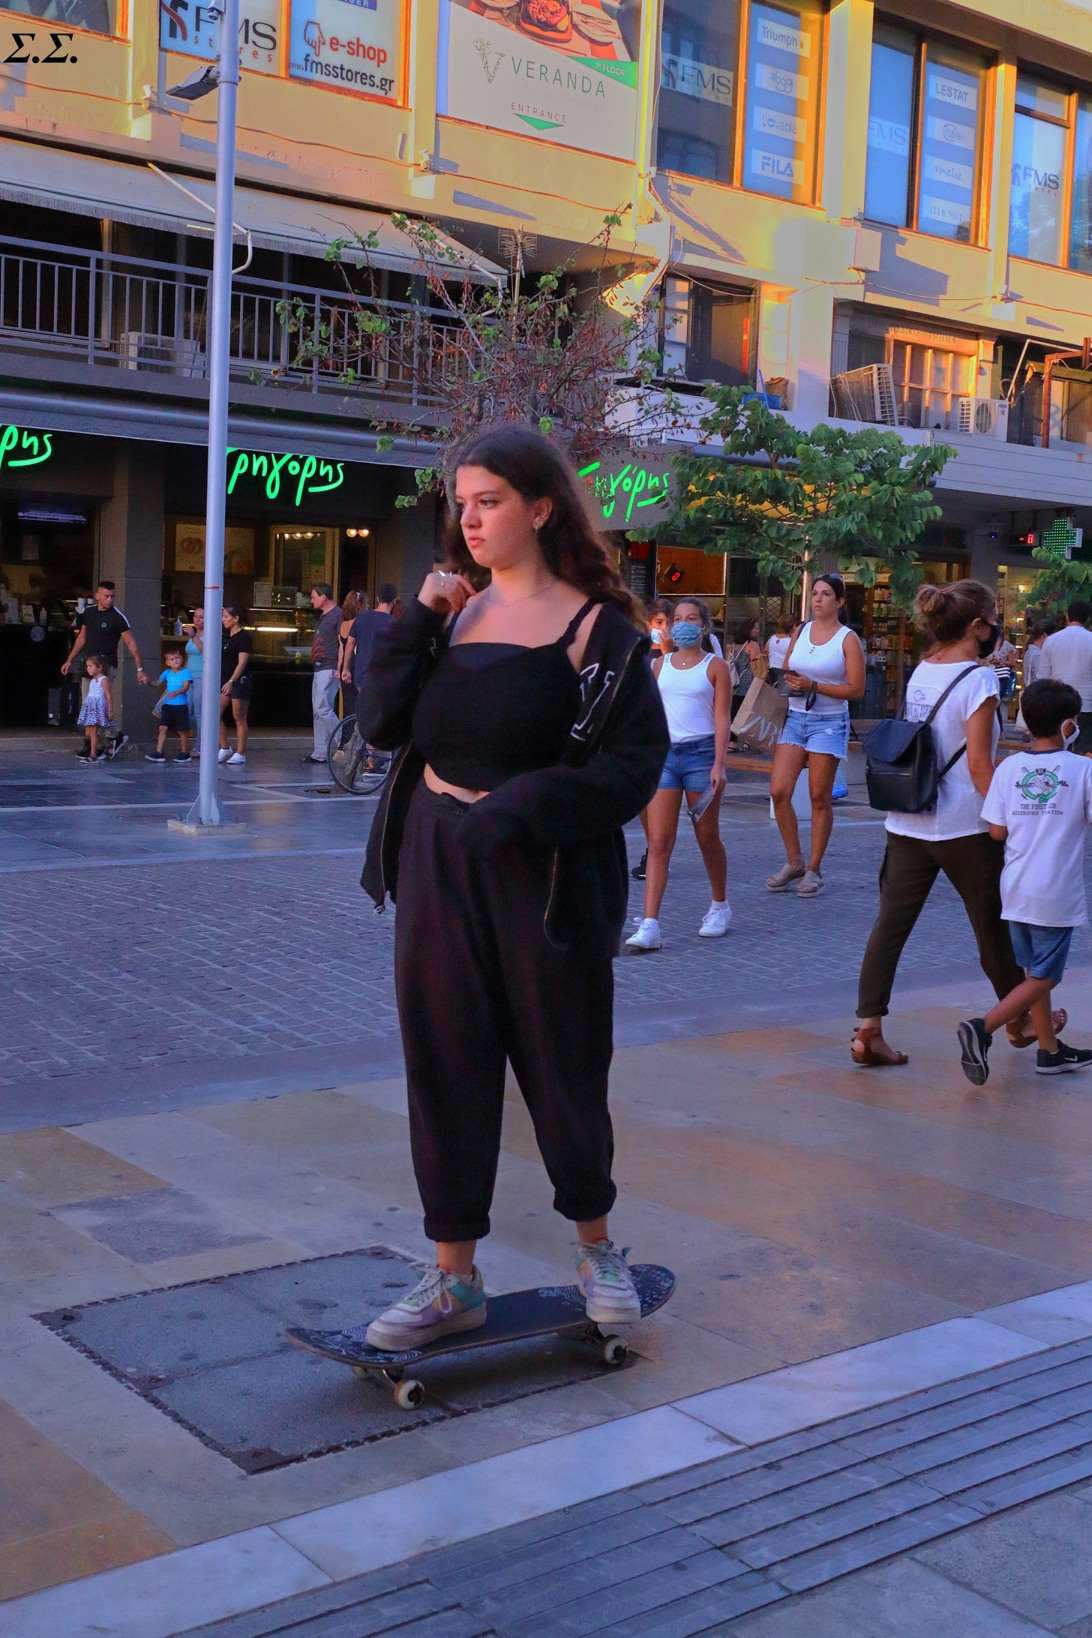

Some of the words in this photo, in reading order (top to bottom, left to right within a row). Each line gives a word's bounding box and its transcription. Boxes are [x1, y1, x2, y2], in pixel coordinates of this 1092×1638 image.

[194, 35, 273, 62] stres
[762, 26, 798, 47] Triumph
[329, 36, 387, 68] e-shop
[511, 56, 606, 98] VERANDA
[602, 64, 626, 76] FLOOR
[681, 65, 731, 95] FMS
[936, 81, 969, 102] LESTAT
[511, 102, 567, 123] ENTRANCE
[762, 155, 794, 178] FILA
[1023, 166, 1060, 190] FMS
[226, 447, 345, 507] ρηγόρης
[740, 710, 782, 748] ZAR
